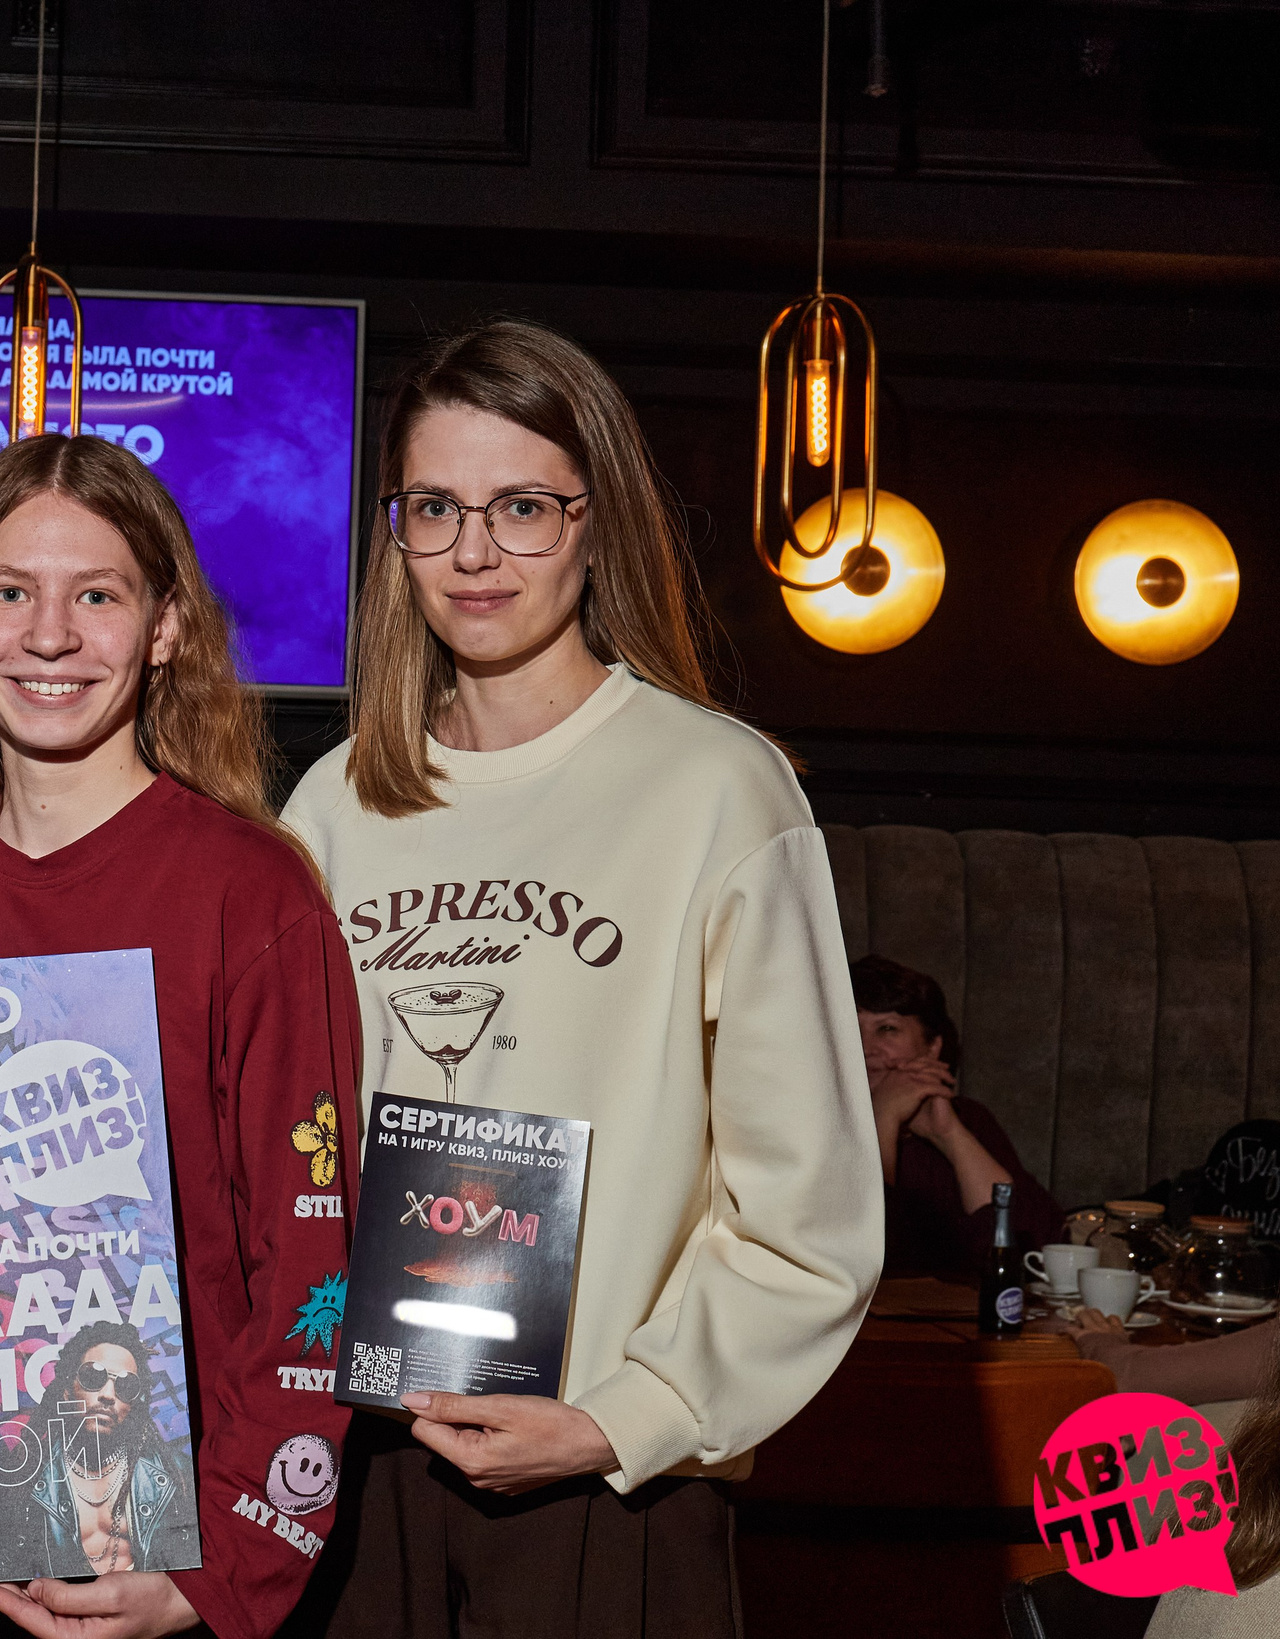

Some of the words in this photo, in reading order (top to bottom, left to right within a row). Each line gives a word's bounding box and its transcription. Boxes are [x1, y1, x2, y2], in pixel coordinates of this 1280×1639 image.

[135, 347, 215, 369] ПОЧТИ
[141, 371, 234, 396] КРУТОЙ
[337, 879, 624, 968] SPRESSO
[360, 925, 530, 972] Martini
[492, 1035, 517, 1050] 1980
[378, 1131, 398, 1147] НА
[401, 1134, 408, 1149] 1
[410, 1136, 446, 1154] ИГРУ
[448, 1142, 489, 1161] КВИЗ,
[492, 1149, 534, 1166] ПЛИЗ!
[379, 1103, 585, 1155] СЕРТИФИКАТ
[400, 1190, 541, 1247] ХОУМ
[27, 1229, 140, 1262] ПОЧТИ
[232, 1493, 276, 1527] MY
[272, 1512, 324, 1559] BEST
